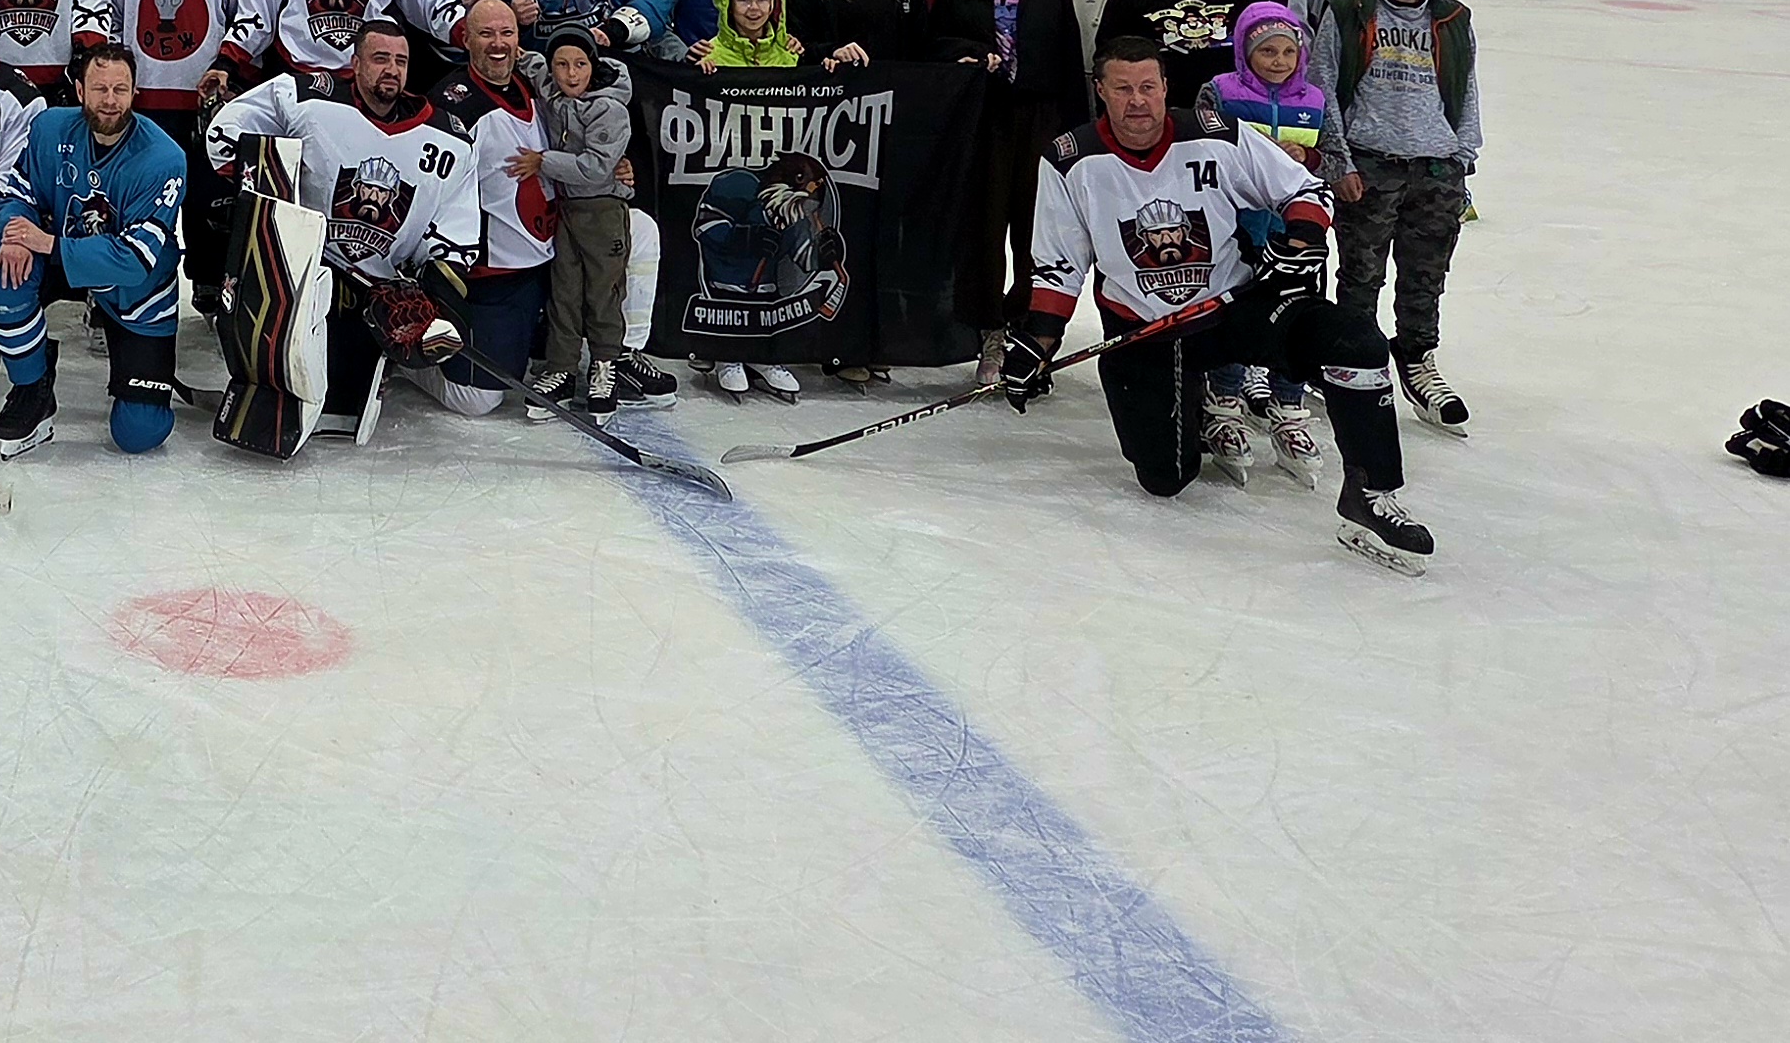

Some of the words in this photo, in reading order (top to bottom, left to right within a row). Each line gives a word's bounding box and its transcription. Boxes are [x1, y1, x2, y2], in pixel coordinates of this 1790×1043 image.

[811, 85, 844, 97] КЛУБ
[660, 88, 893, 190] ФИНИСТ
[418, 143, 456, 179] 30
[694, 305, 750, 327] ФИНИСТ
[760, 297, 813, 327] МОСКВА
